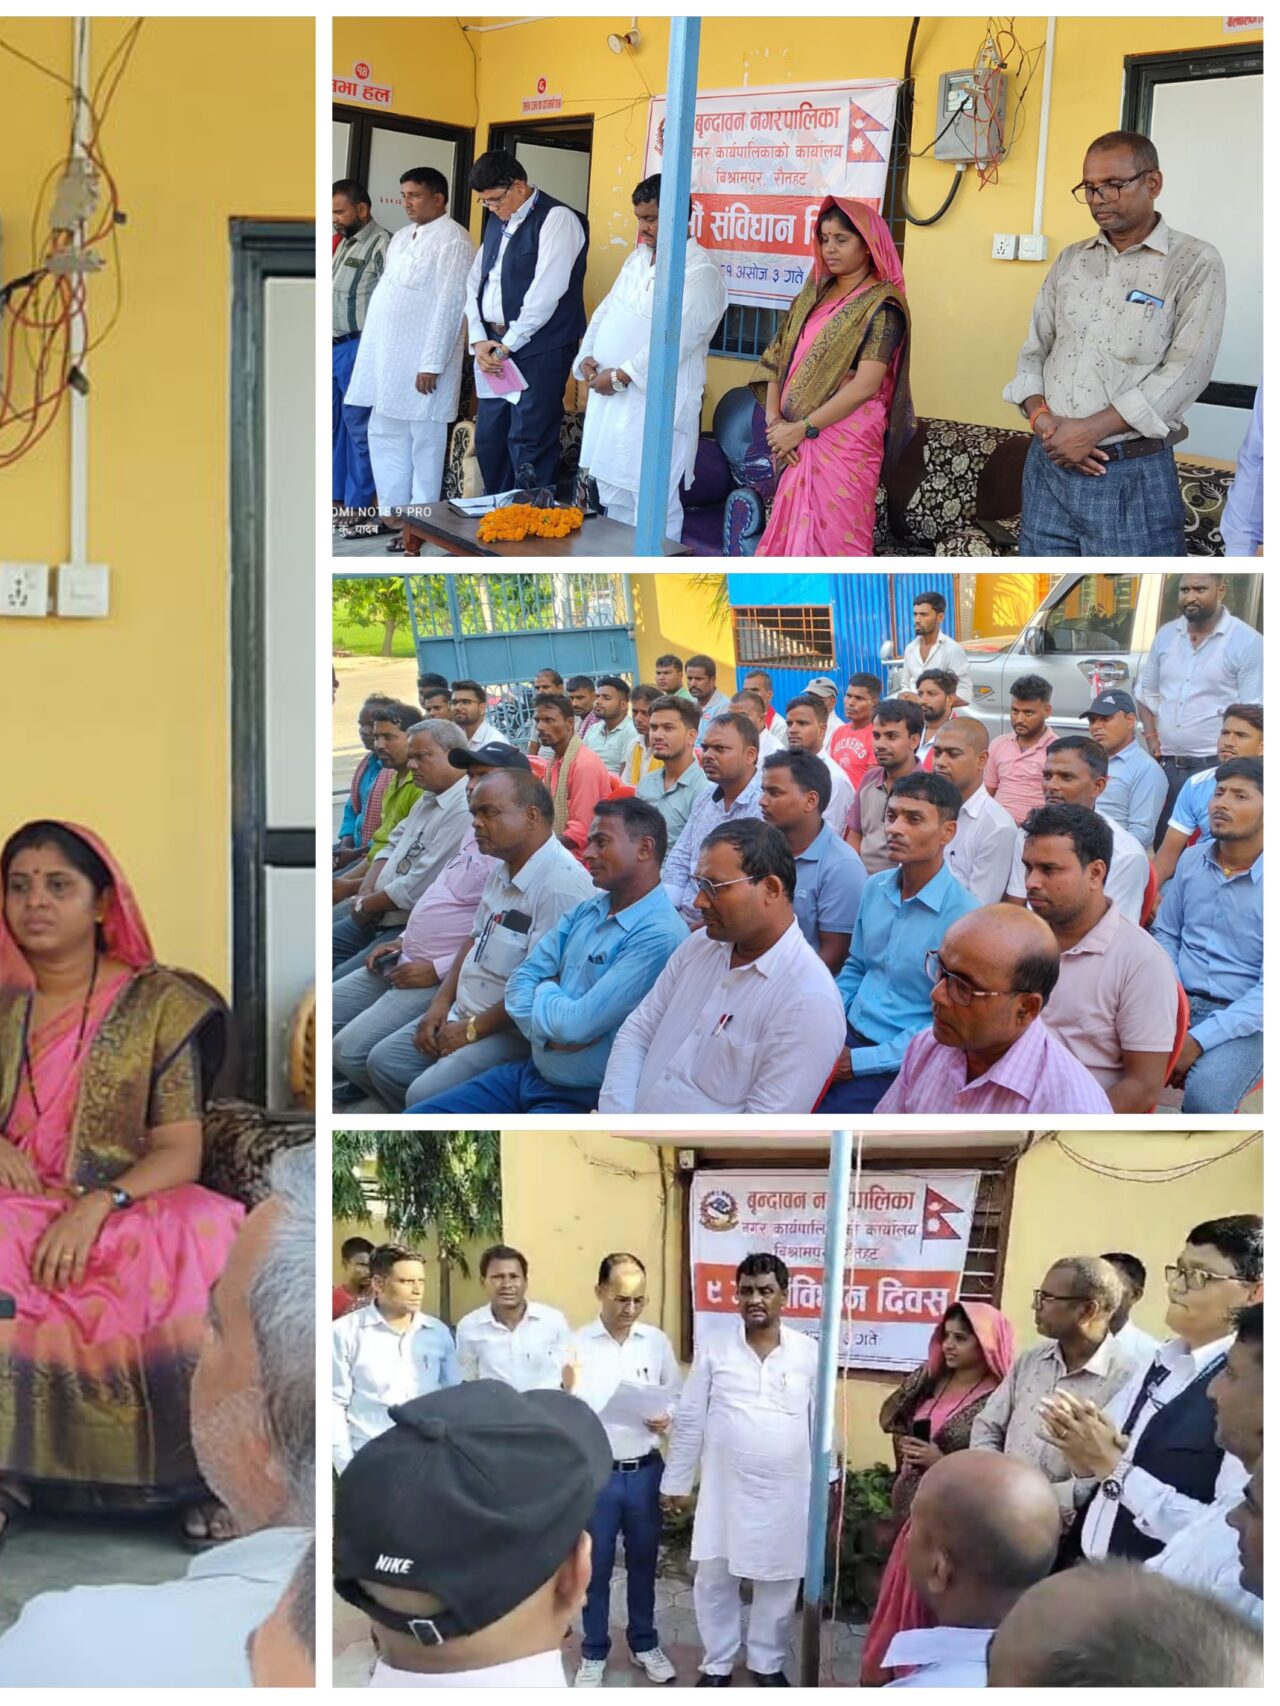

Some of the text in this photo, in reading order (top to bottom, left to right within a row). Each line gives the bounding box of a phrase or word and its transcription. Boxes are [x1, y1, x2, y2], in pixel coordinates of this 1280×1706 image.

[362, 85, 391, 102] हल
[695, 101, 840, 139] बृन्दावन नगरपालिका
[716, 141, 789, 159] कार्यपालिकाको
[796, 142, 844, 159] कार्यालय
[710, 202, 797, 244] संविधान
[736, 262, 768, 281] असोज
[772, 268, 780, 283] ३
[784, 266, 804, 284] गते
[706, 1279, 722, 1304] ९
[877, 1277, 951, 1317] दिवस
[374, 1553, 415, 1574] NIKE
